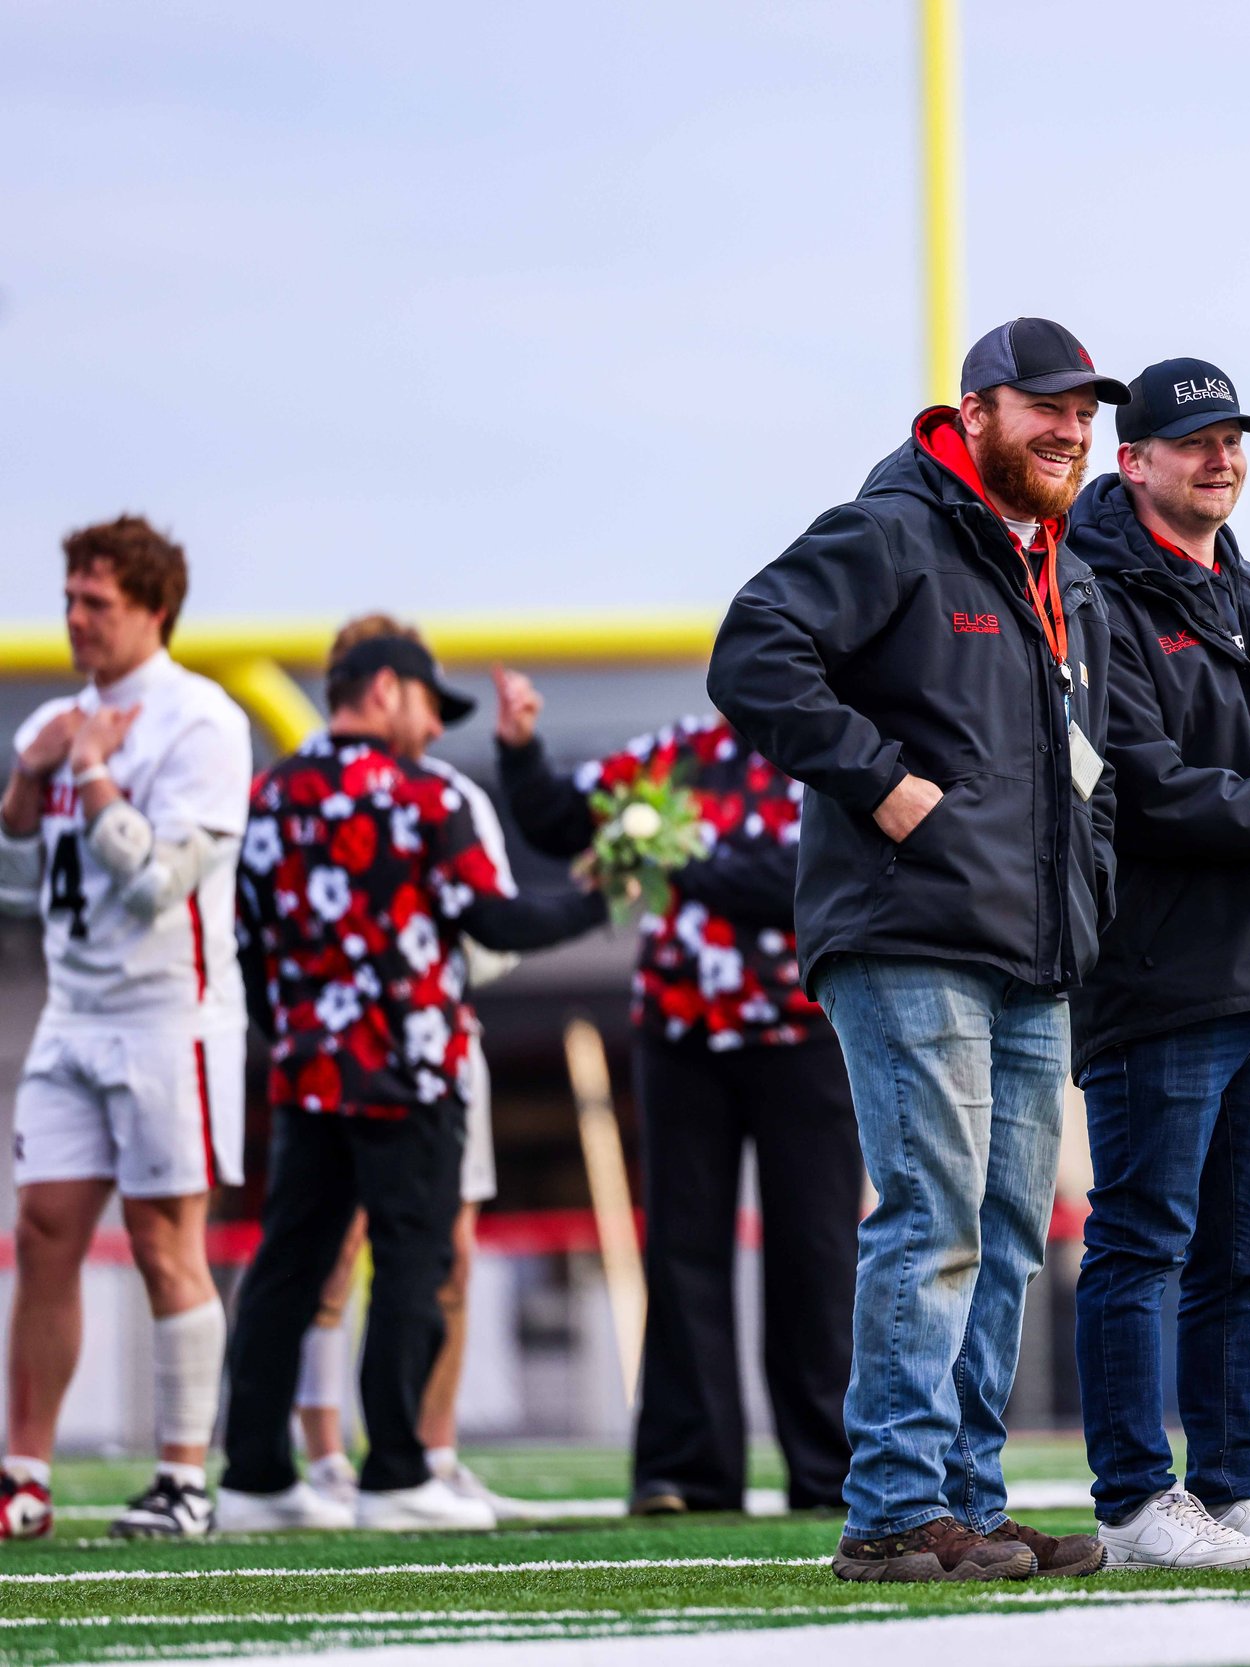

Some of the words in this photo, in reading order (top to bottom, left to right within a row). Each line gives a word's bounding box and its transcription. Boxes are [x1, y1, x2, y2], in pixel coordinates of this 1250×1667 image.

[1173, 377, 1231, 397] ELKS
[953, 612, 999, 627] ELKS
[953, 625, 1001, 634] LACROSSE
[51, 832, 86, 939] 4
